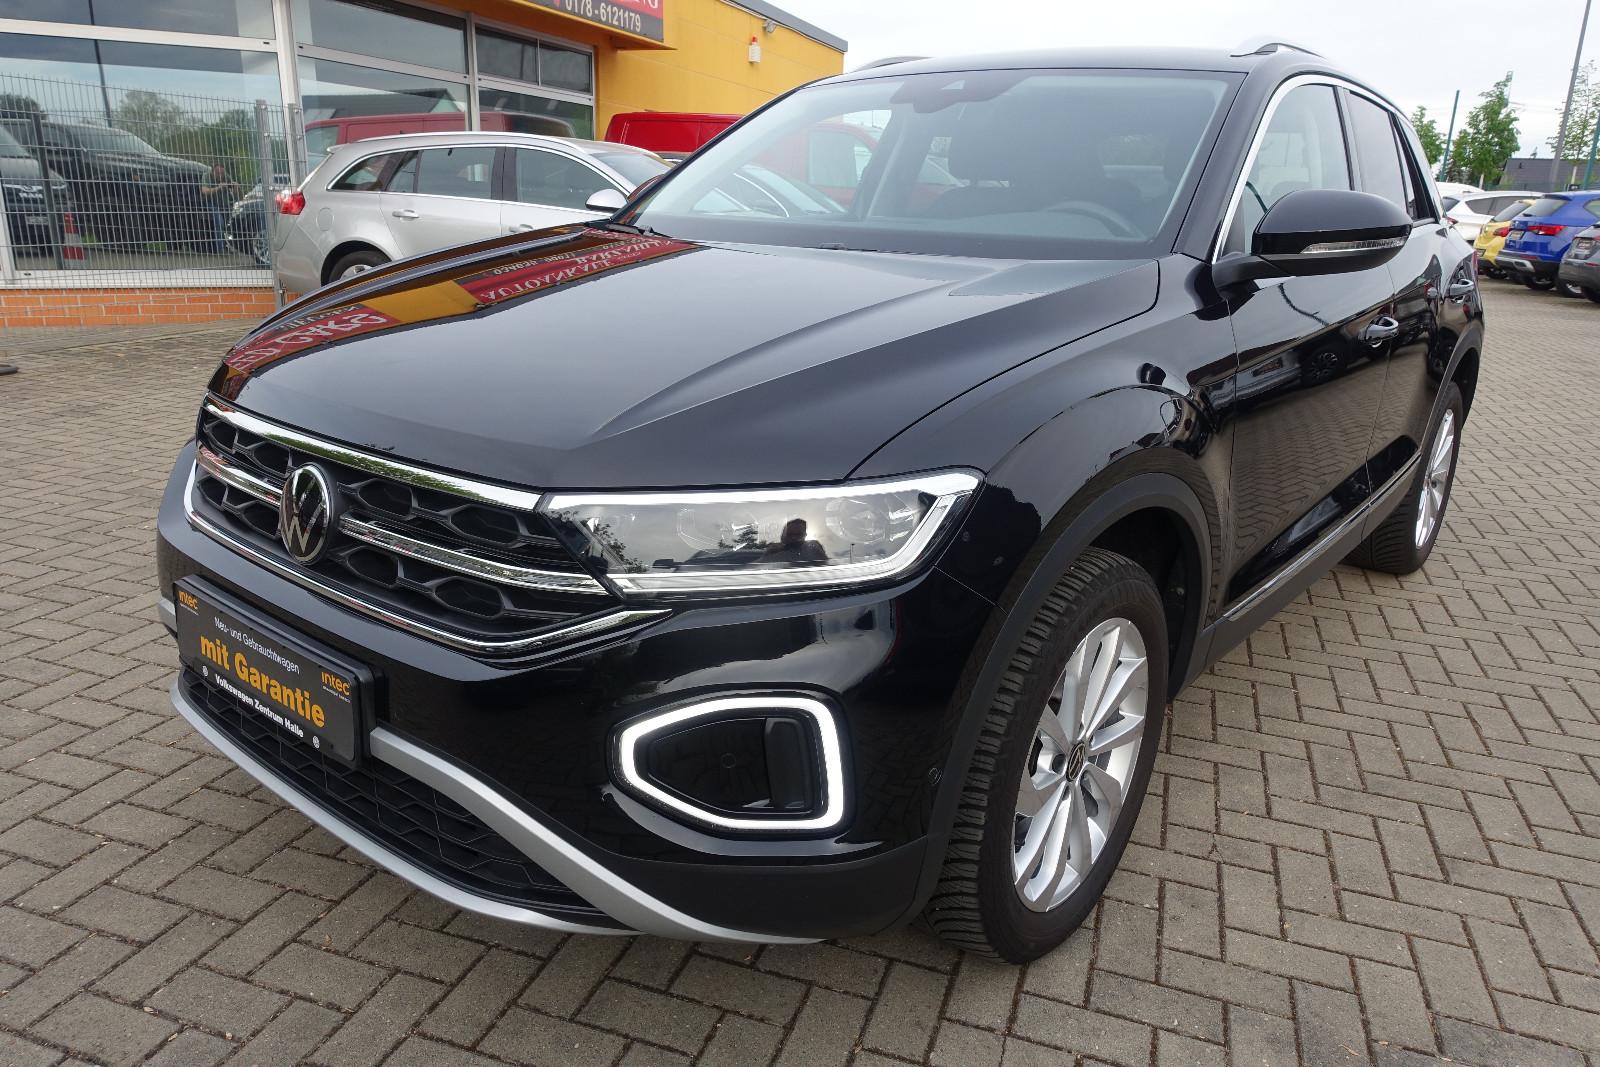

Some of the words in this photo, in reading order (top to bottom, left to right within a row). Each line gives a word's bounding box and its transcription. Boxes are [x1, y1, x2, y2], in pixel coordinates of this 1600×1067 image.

[214, 616, 230, 633] Neu-
[230, 627, 242, 641] und
[242, 633, 300, 675] Gebrauchtwagen
[200, 635, 230, 671] mit
[234, 652, 325, 728] Garantie
[215, 674, 254, 705] Volkswagen
[254, 698, 284, 726] Zentrum
[284, 717, 304, 738] Halle
